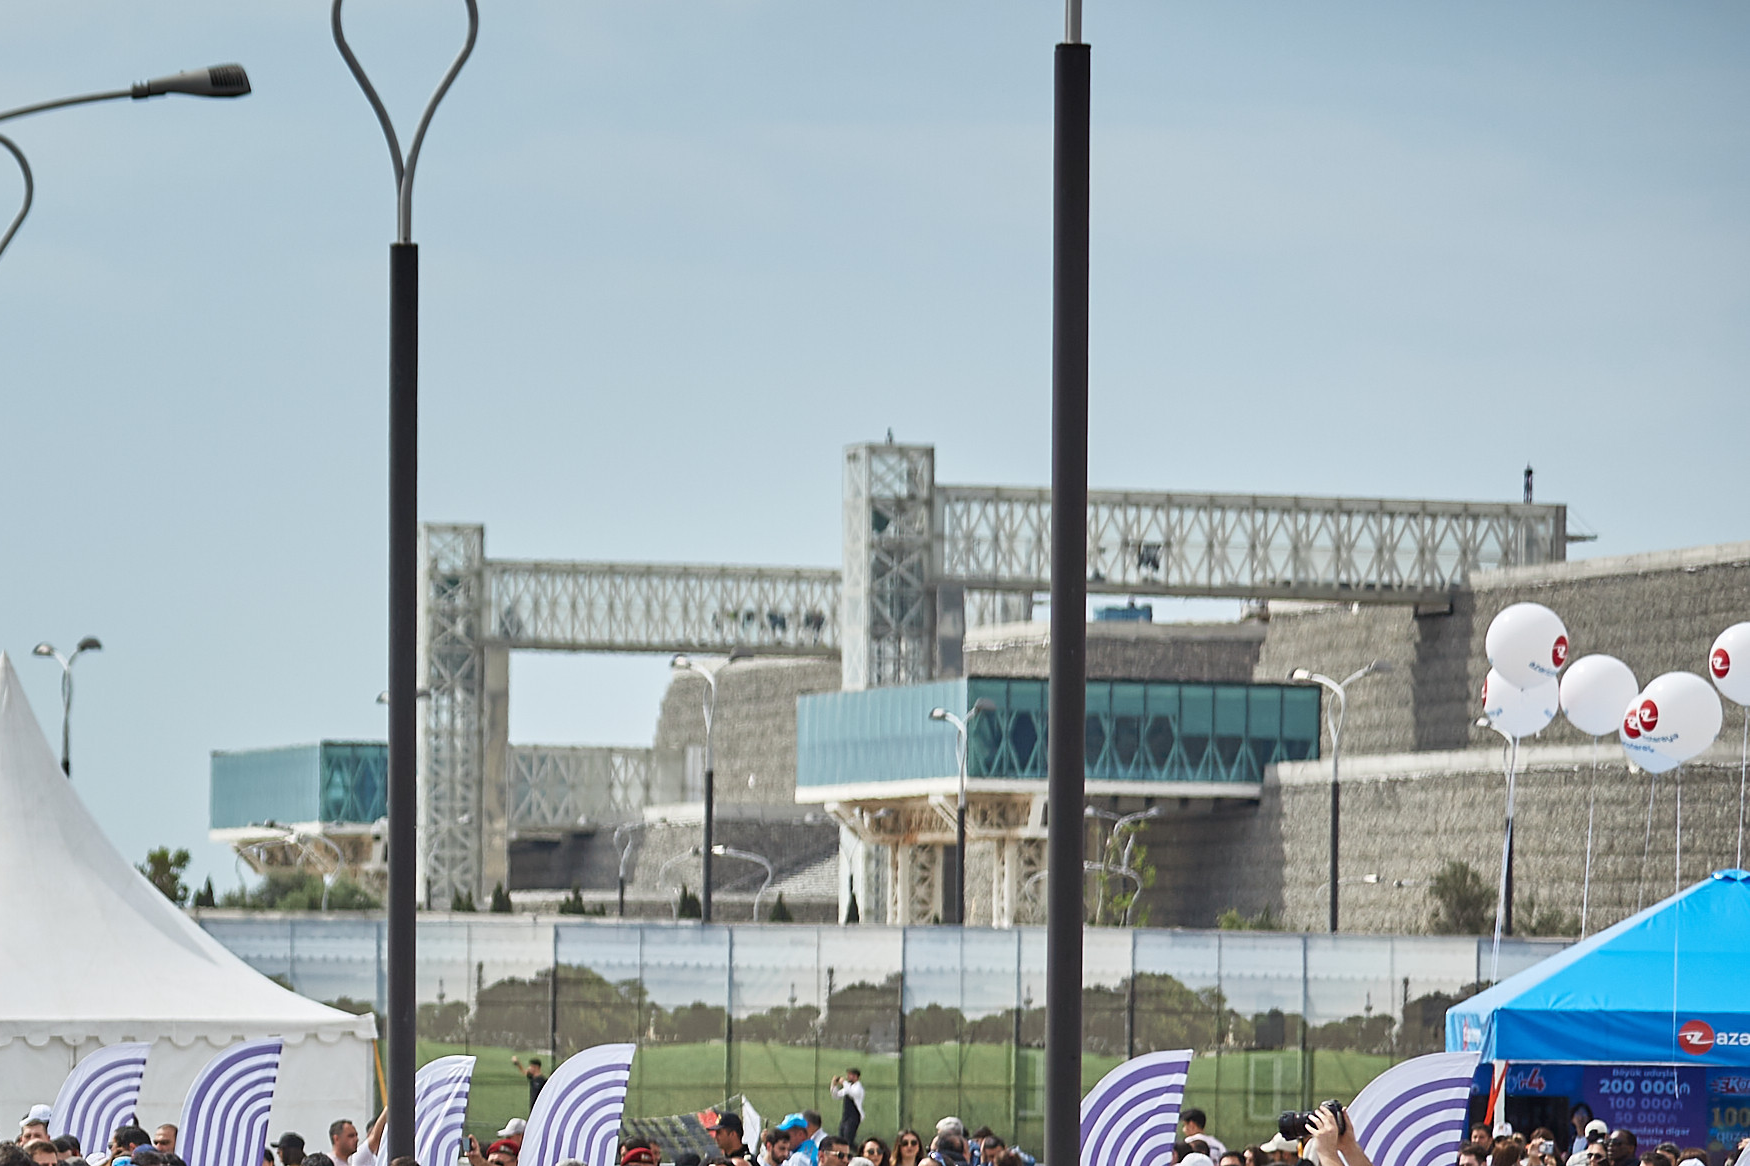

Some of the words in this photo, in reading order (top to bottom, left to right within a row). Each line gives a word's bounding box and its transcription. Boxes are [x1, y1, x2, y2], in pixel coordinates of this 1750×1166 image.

[1599, 1079, 1635, 1095] 200
[1609, 1097, 1636, 1110] 100
[1614, 1112, 1633, 1124] 50
